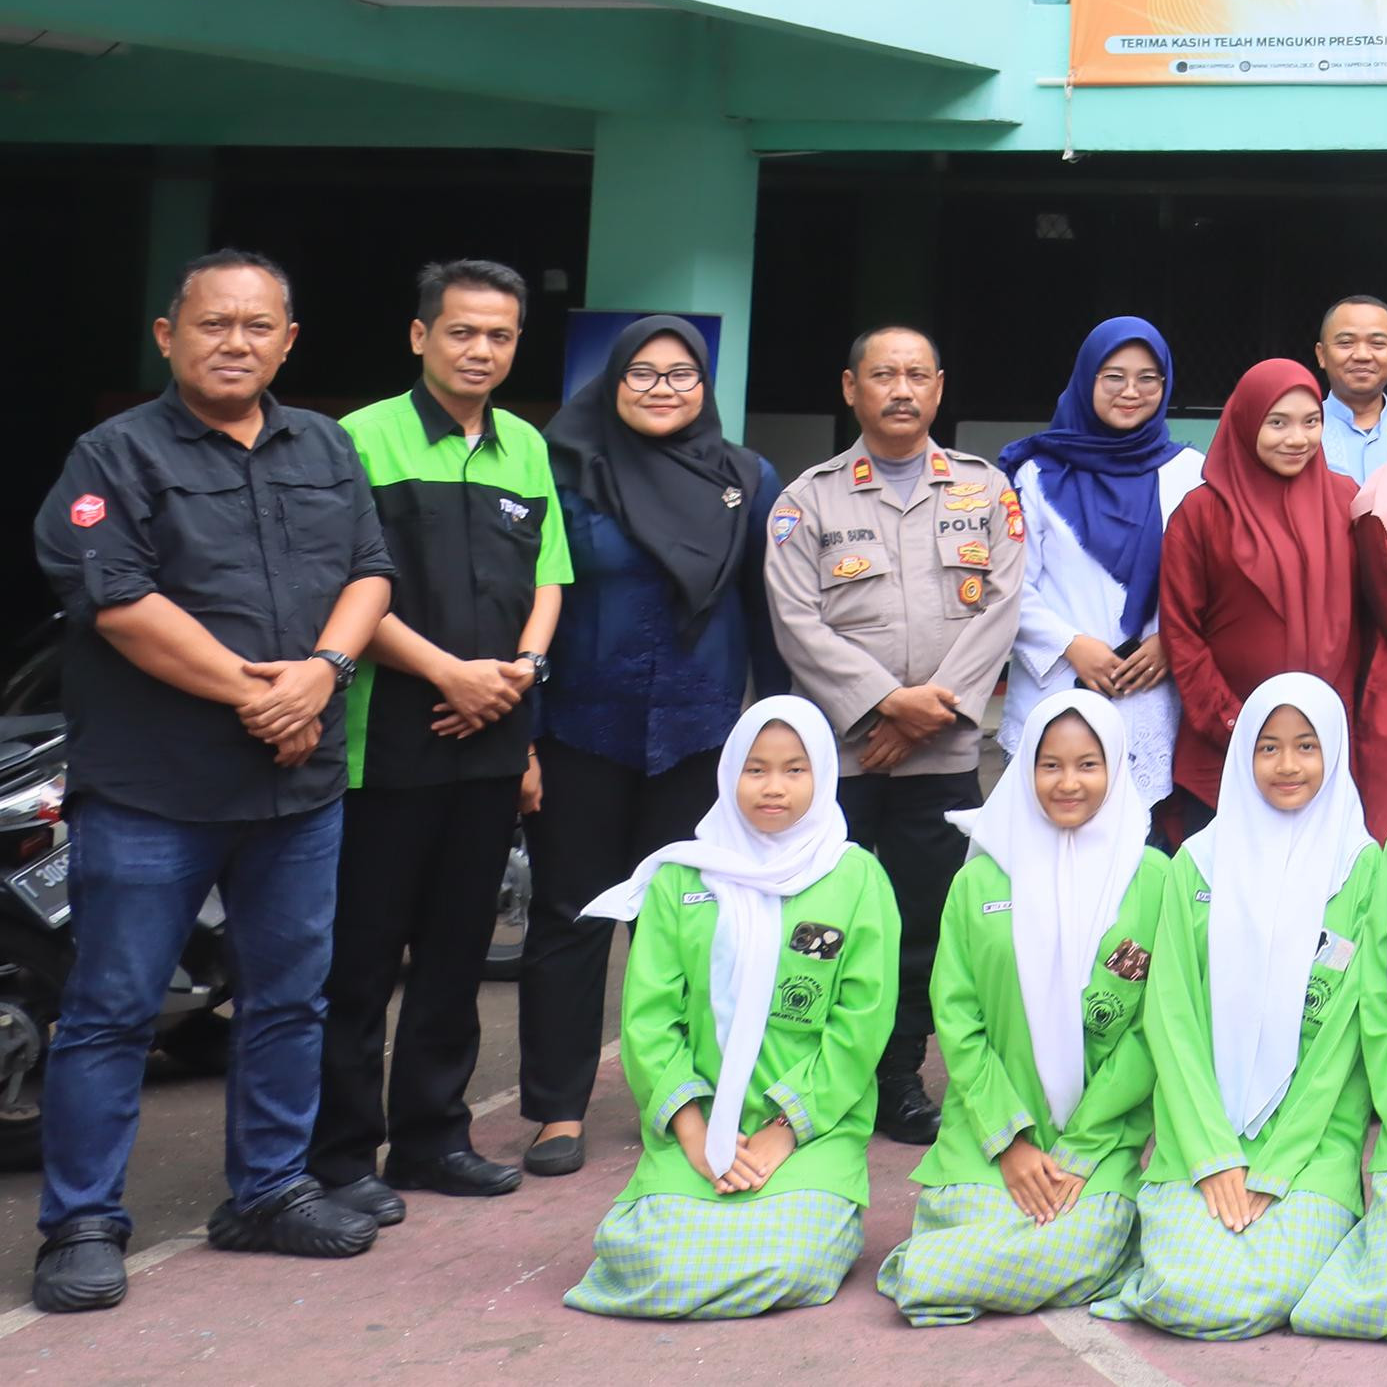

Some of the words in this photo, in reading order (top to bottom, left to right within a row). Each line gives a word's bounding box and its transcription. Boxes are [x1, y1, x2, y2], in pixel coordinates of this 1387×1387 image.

[1121, 38, 1168, 48] TERIMA
[1172, 38, 1210, 48] KASIH
[1214, 37, 1252, 47] TELAH
[1256, 37, 1326, 47] MENGUKIR
[1329, 36, 1387, 46] PRESTASI
[939, 517, 990, 535] POLR
[821, 531, 844, 549] GUS
